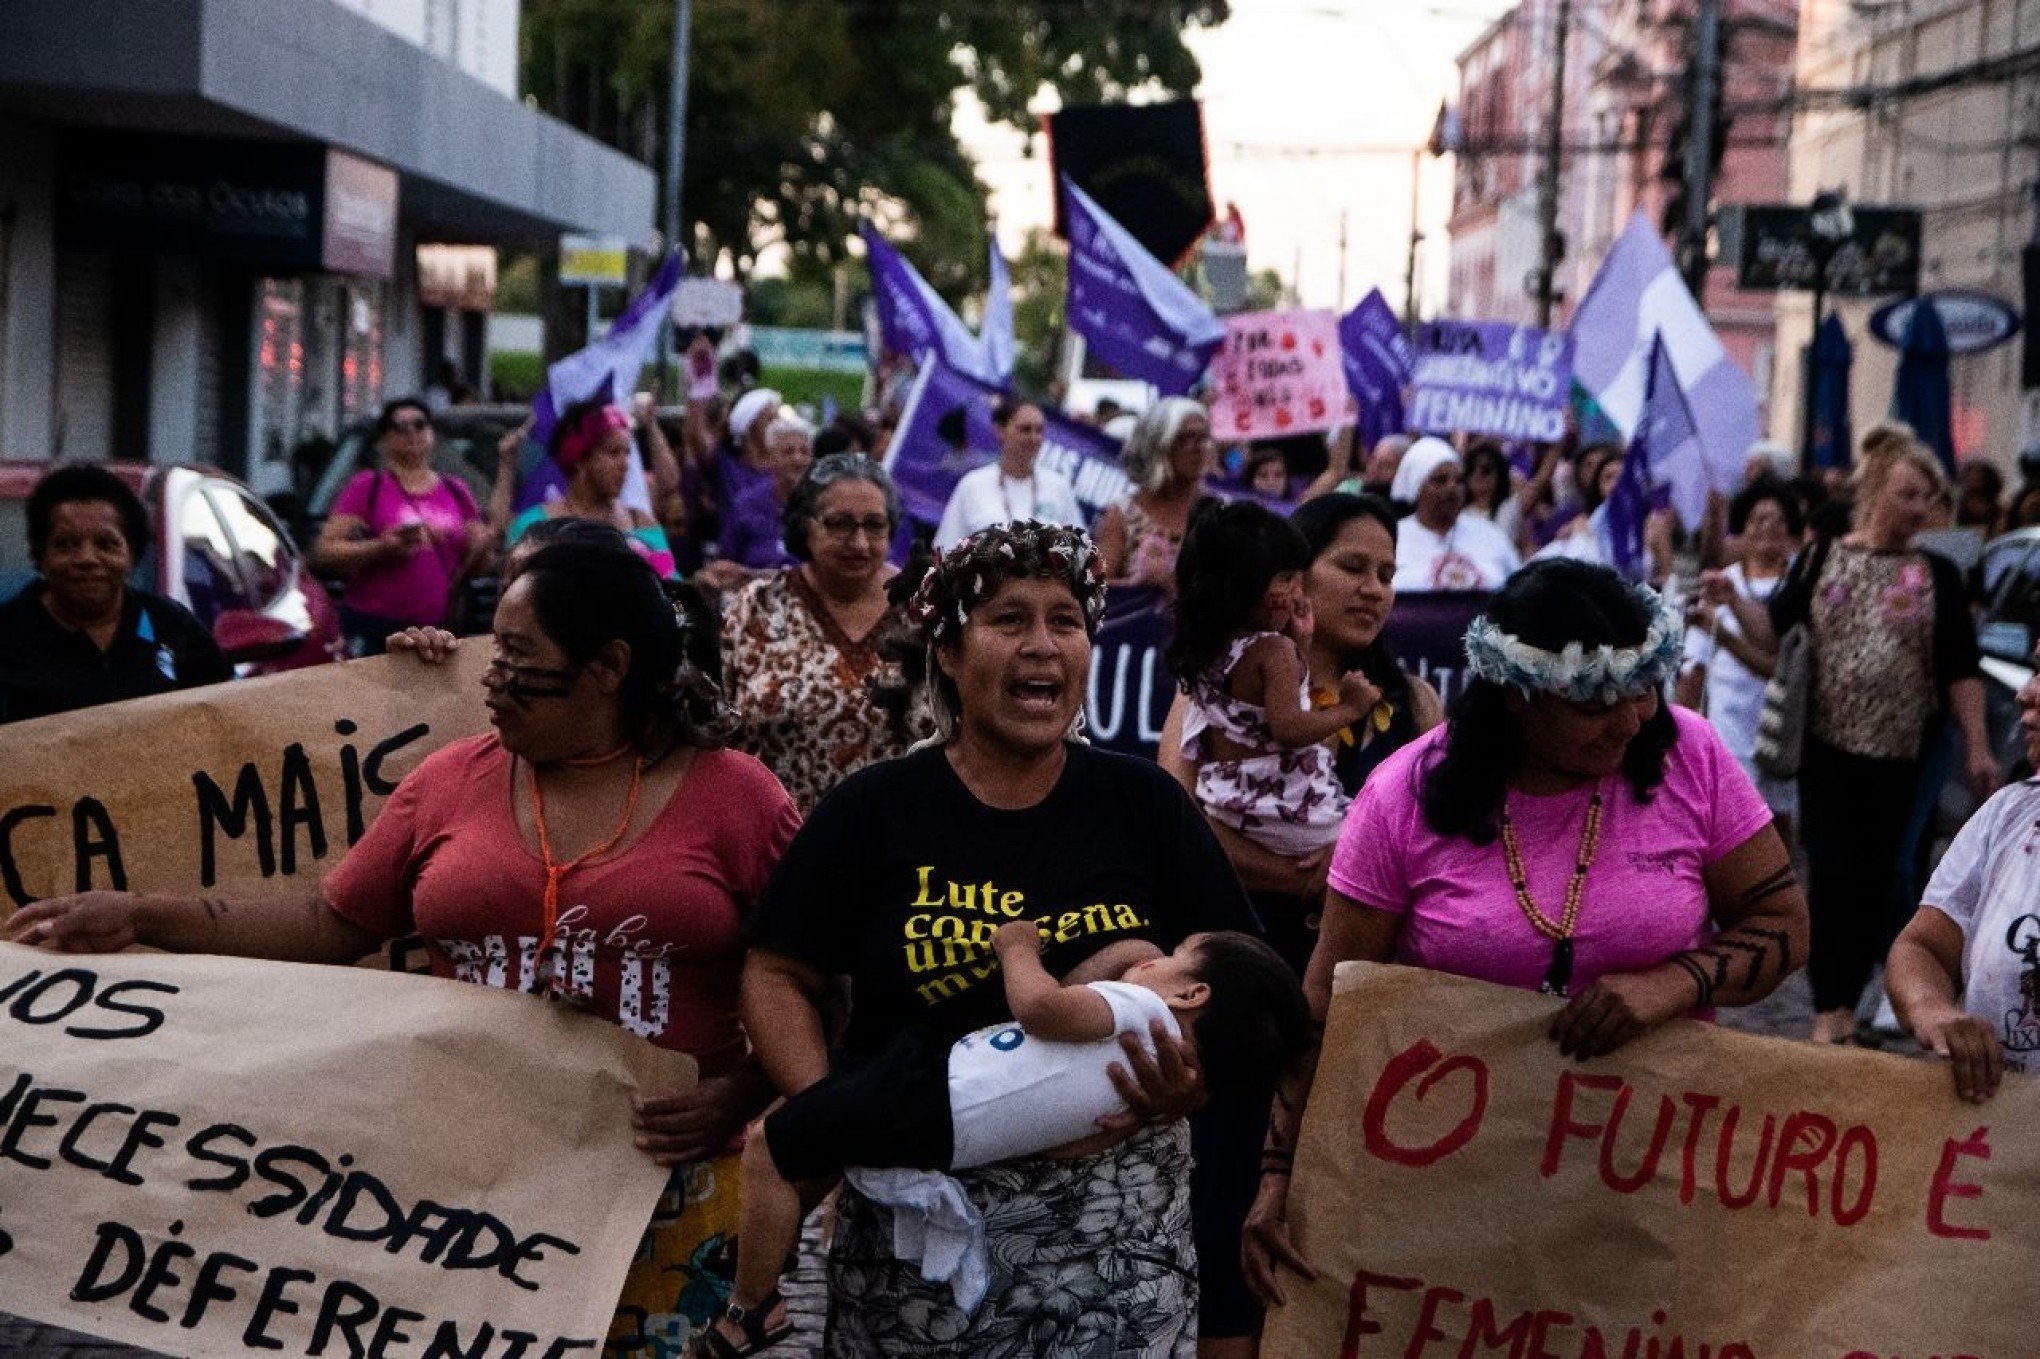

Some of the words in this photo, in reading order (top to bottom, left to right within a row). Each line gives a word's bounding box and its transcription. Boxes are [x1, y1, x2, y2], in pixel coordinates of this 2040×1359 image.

[910, 866, 1025, 917] Lute
[1362, 1038, 1489, 1168] O
[1539, 1069, 1878, 1227] FUTURO
[1927, 1125, 1991, 1241] É
